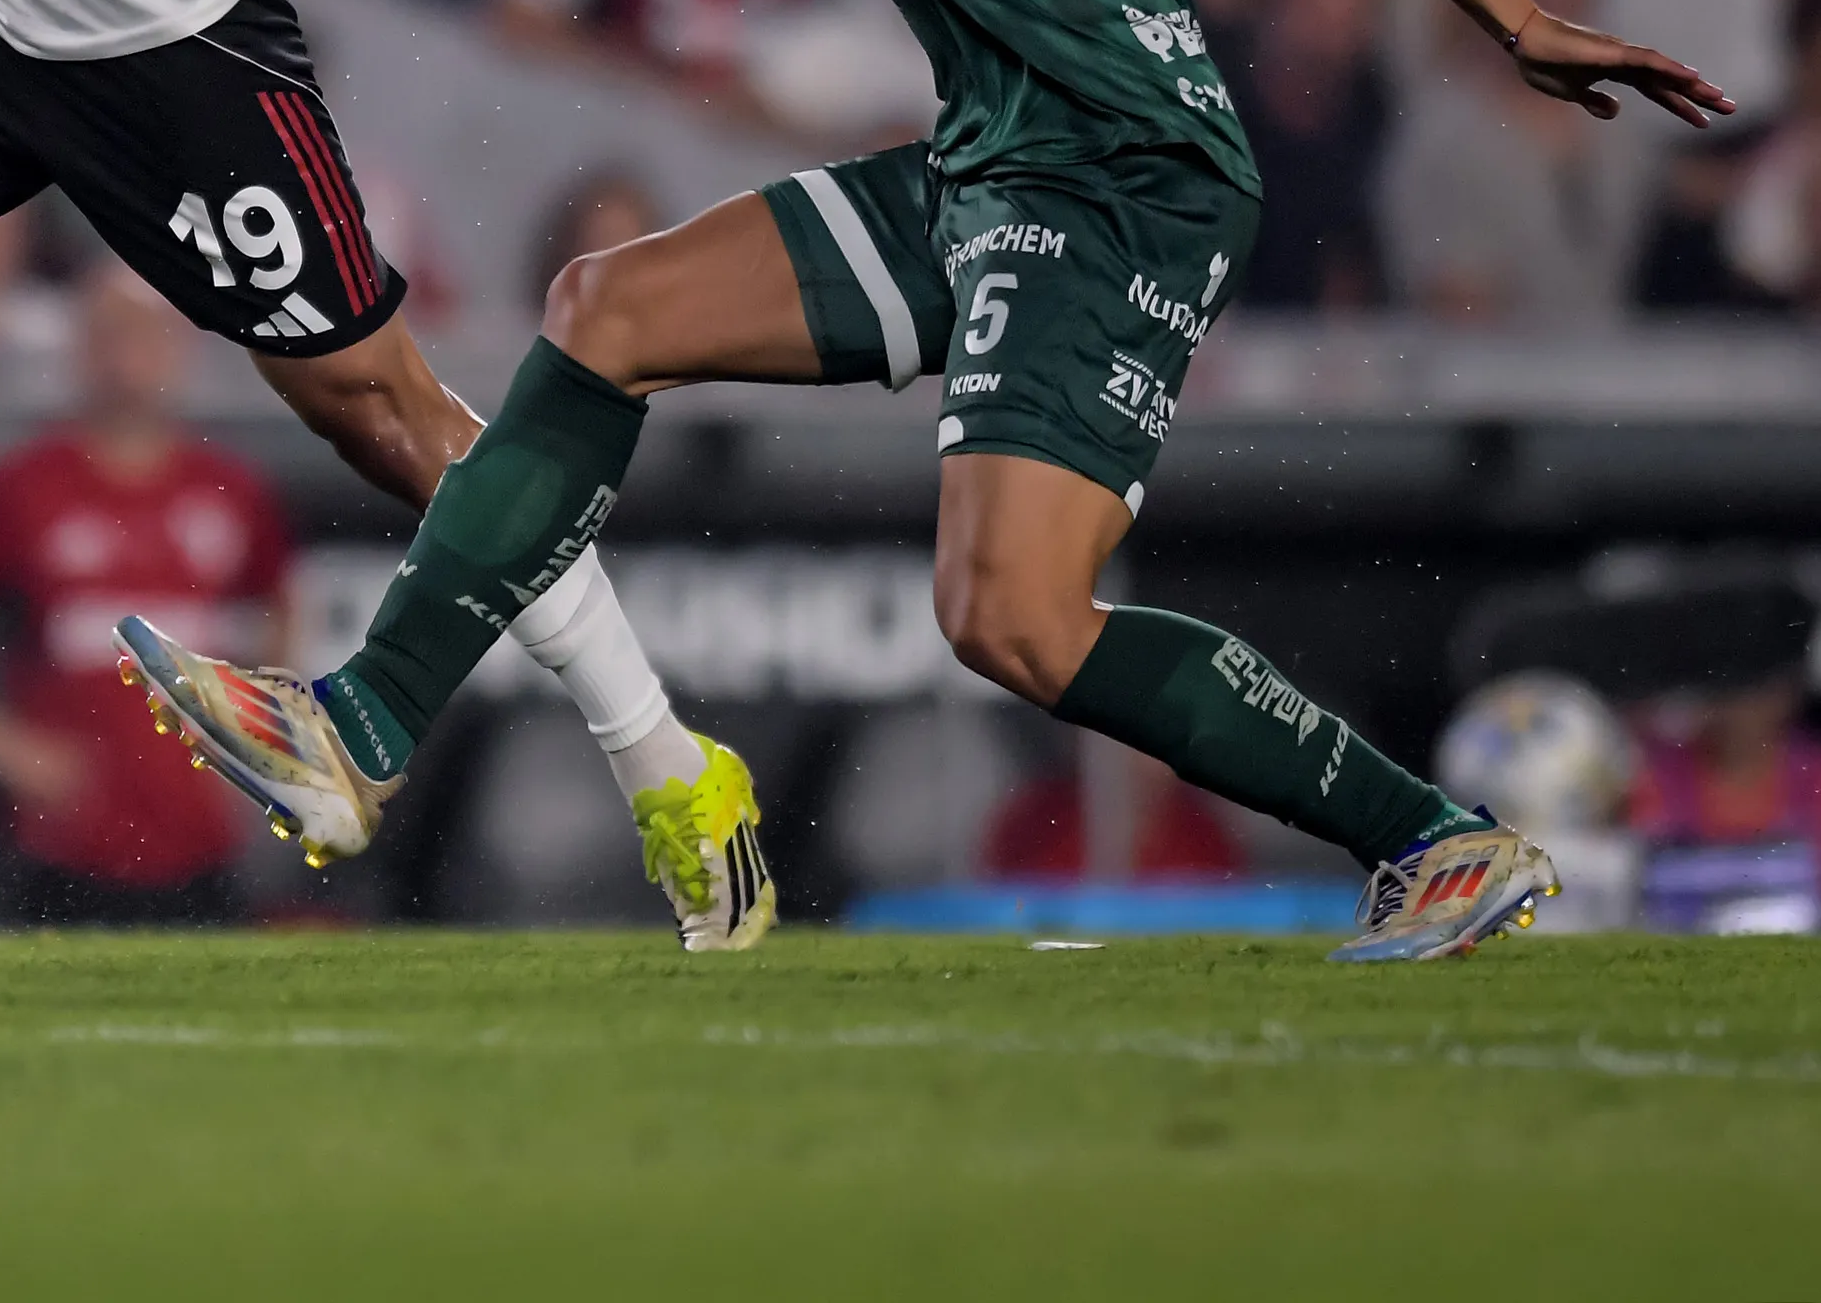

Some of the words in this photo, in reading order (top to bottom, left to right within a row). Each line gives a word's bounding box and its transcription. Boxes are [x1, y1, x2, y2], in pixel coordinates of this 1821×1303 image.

[168, 185, 303, 290] 19
[964, 272, 1019, 356] 5
[949, 372, 1002, 397] KION
[1105, 362, 1149, 408] ZV
